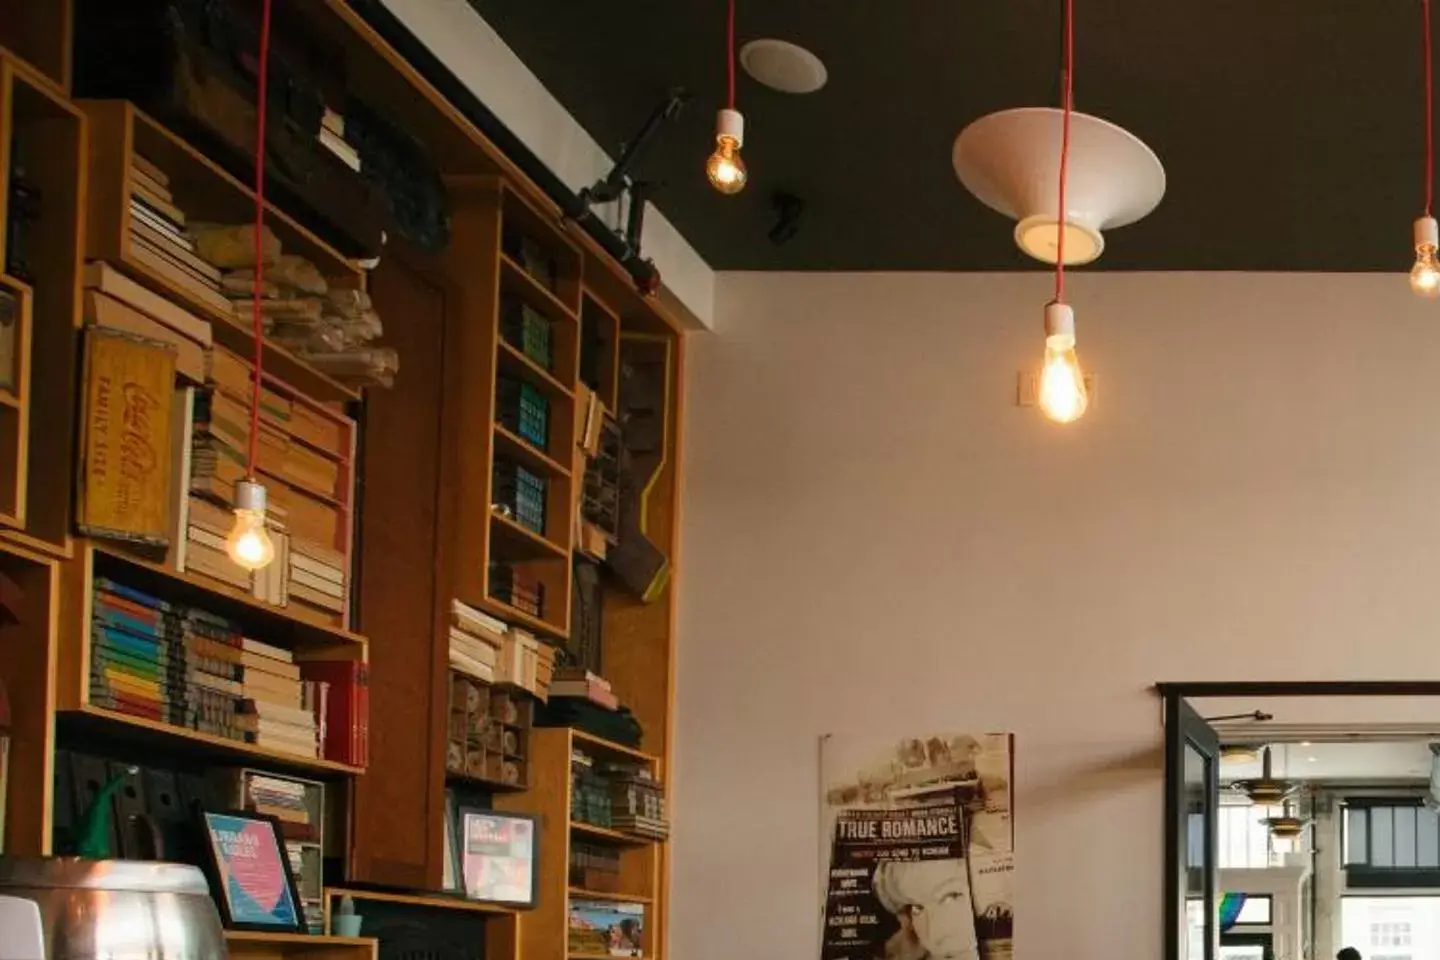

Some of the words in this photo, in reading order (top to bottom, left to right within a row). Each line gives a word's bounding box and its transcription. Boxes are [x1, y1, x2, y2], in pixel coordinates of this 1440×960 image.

[93, 376, 111, 436] FAMILY
[839, 821, 879, 839] TRUE
[881, 816, 960, 838] ROMANCE
